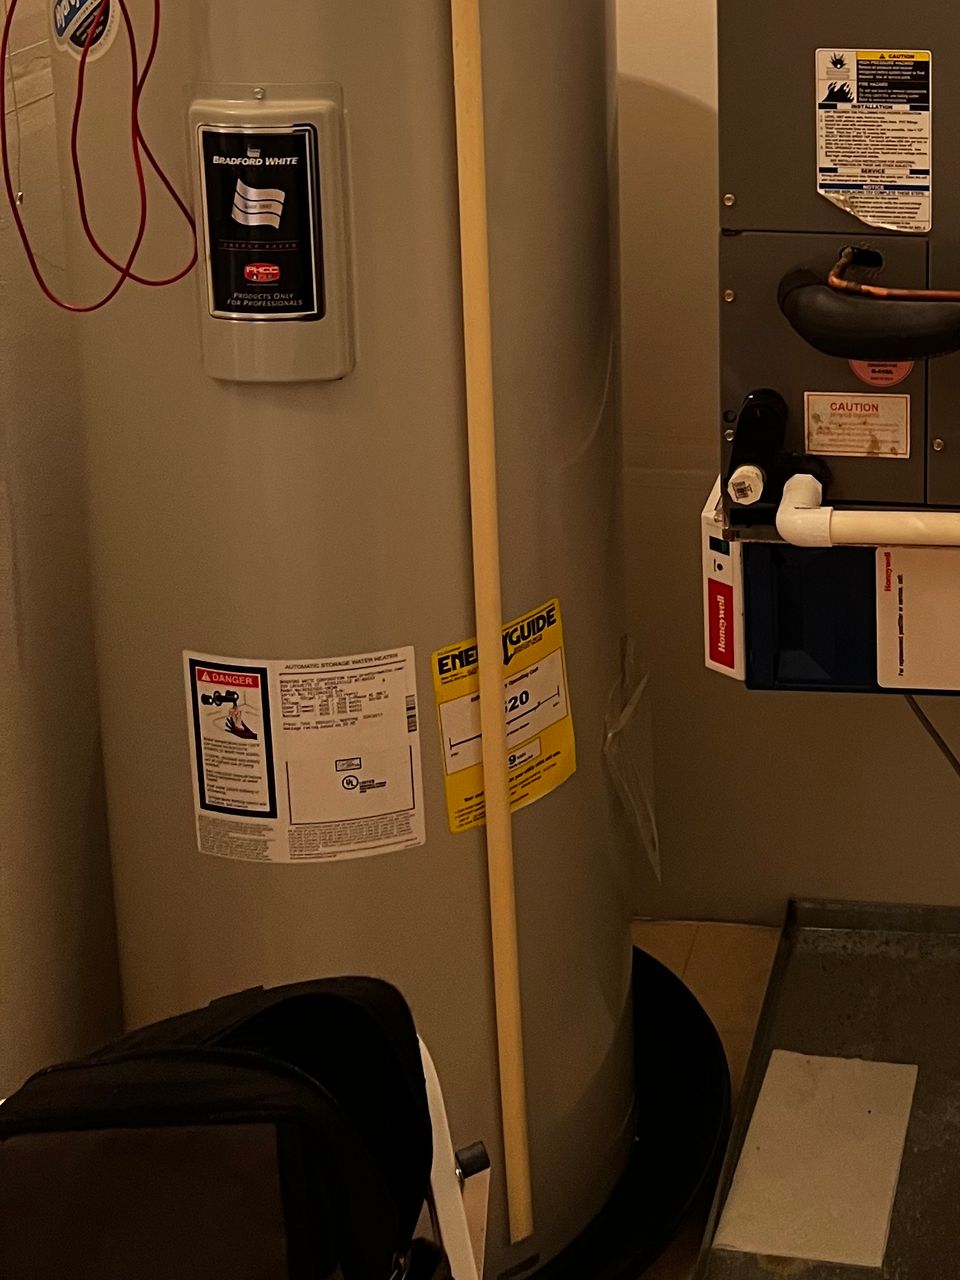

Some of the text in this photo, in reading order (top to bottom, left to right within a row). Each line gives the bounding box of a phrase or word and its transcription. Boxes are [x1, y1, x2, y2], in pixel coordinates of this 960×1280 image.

[212, 155, 299, 166] BRADFORD WHITE
[246, 265, 280, 274] PHCC
[233, 291, 294, 300] PRODUCTS ONLY
[227, 298, 303, 308] FOR PROFESSIONALS
[830, 402, 879, 412] CAUTION
[884, 551, 893, 592] Honeywell
[717, 595, 728, 653] Honeywell
[320, 660, 350, 669] STORAGE
[351, 657, 373, 665] WATER
[374, 653, 398, 662] HEATER
[212, 673, 253, 685] DANGER
[505, 690, 530, 713] 20
